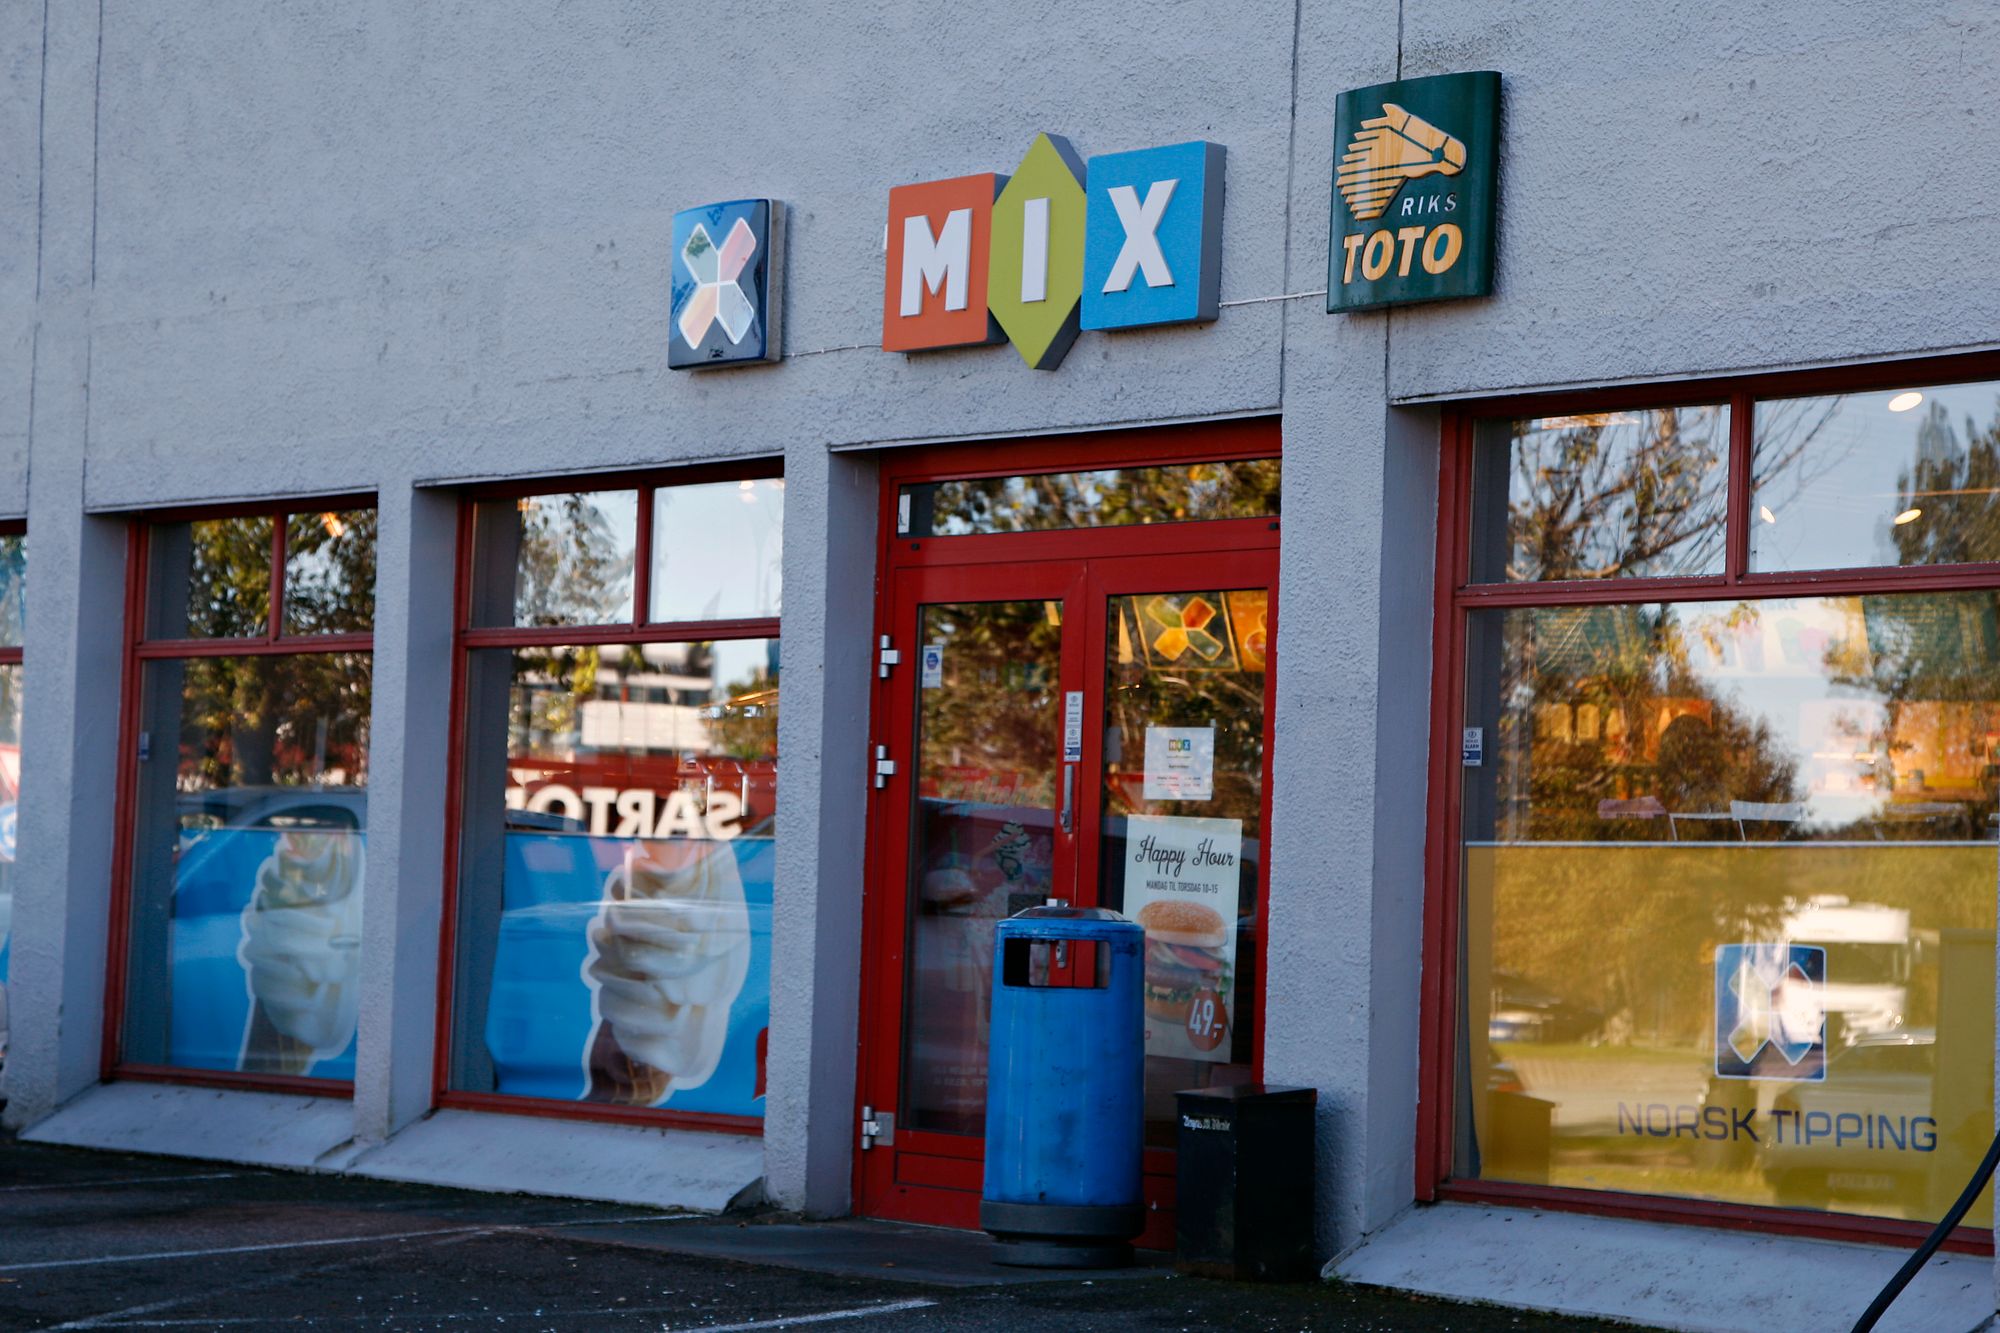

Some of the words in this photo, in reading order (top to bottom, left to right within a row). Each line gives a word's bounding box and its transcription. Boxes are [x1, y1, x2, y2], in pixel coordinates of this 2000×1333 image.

[1401, 191, 1458, 218] RIKS
[899, 178, 1180, 318] MIX
[1341, 223, 1464, 286] TOTO
[1135, 834, 1186, 878] Happy
[1192, 837, 1234, 868] Hour
[1146, 879, 1168, 891] MANDAG
[1178, 882, 1201, 893] TORSDAG
[1618, 1101, 1761, 1142] NORSK
[1767, 1109, 1937, 1152] TIPPING
